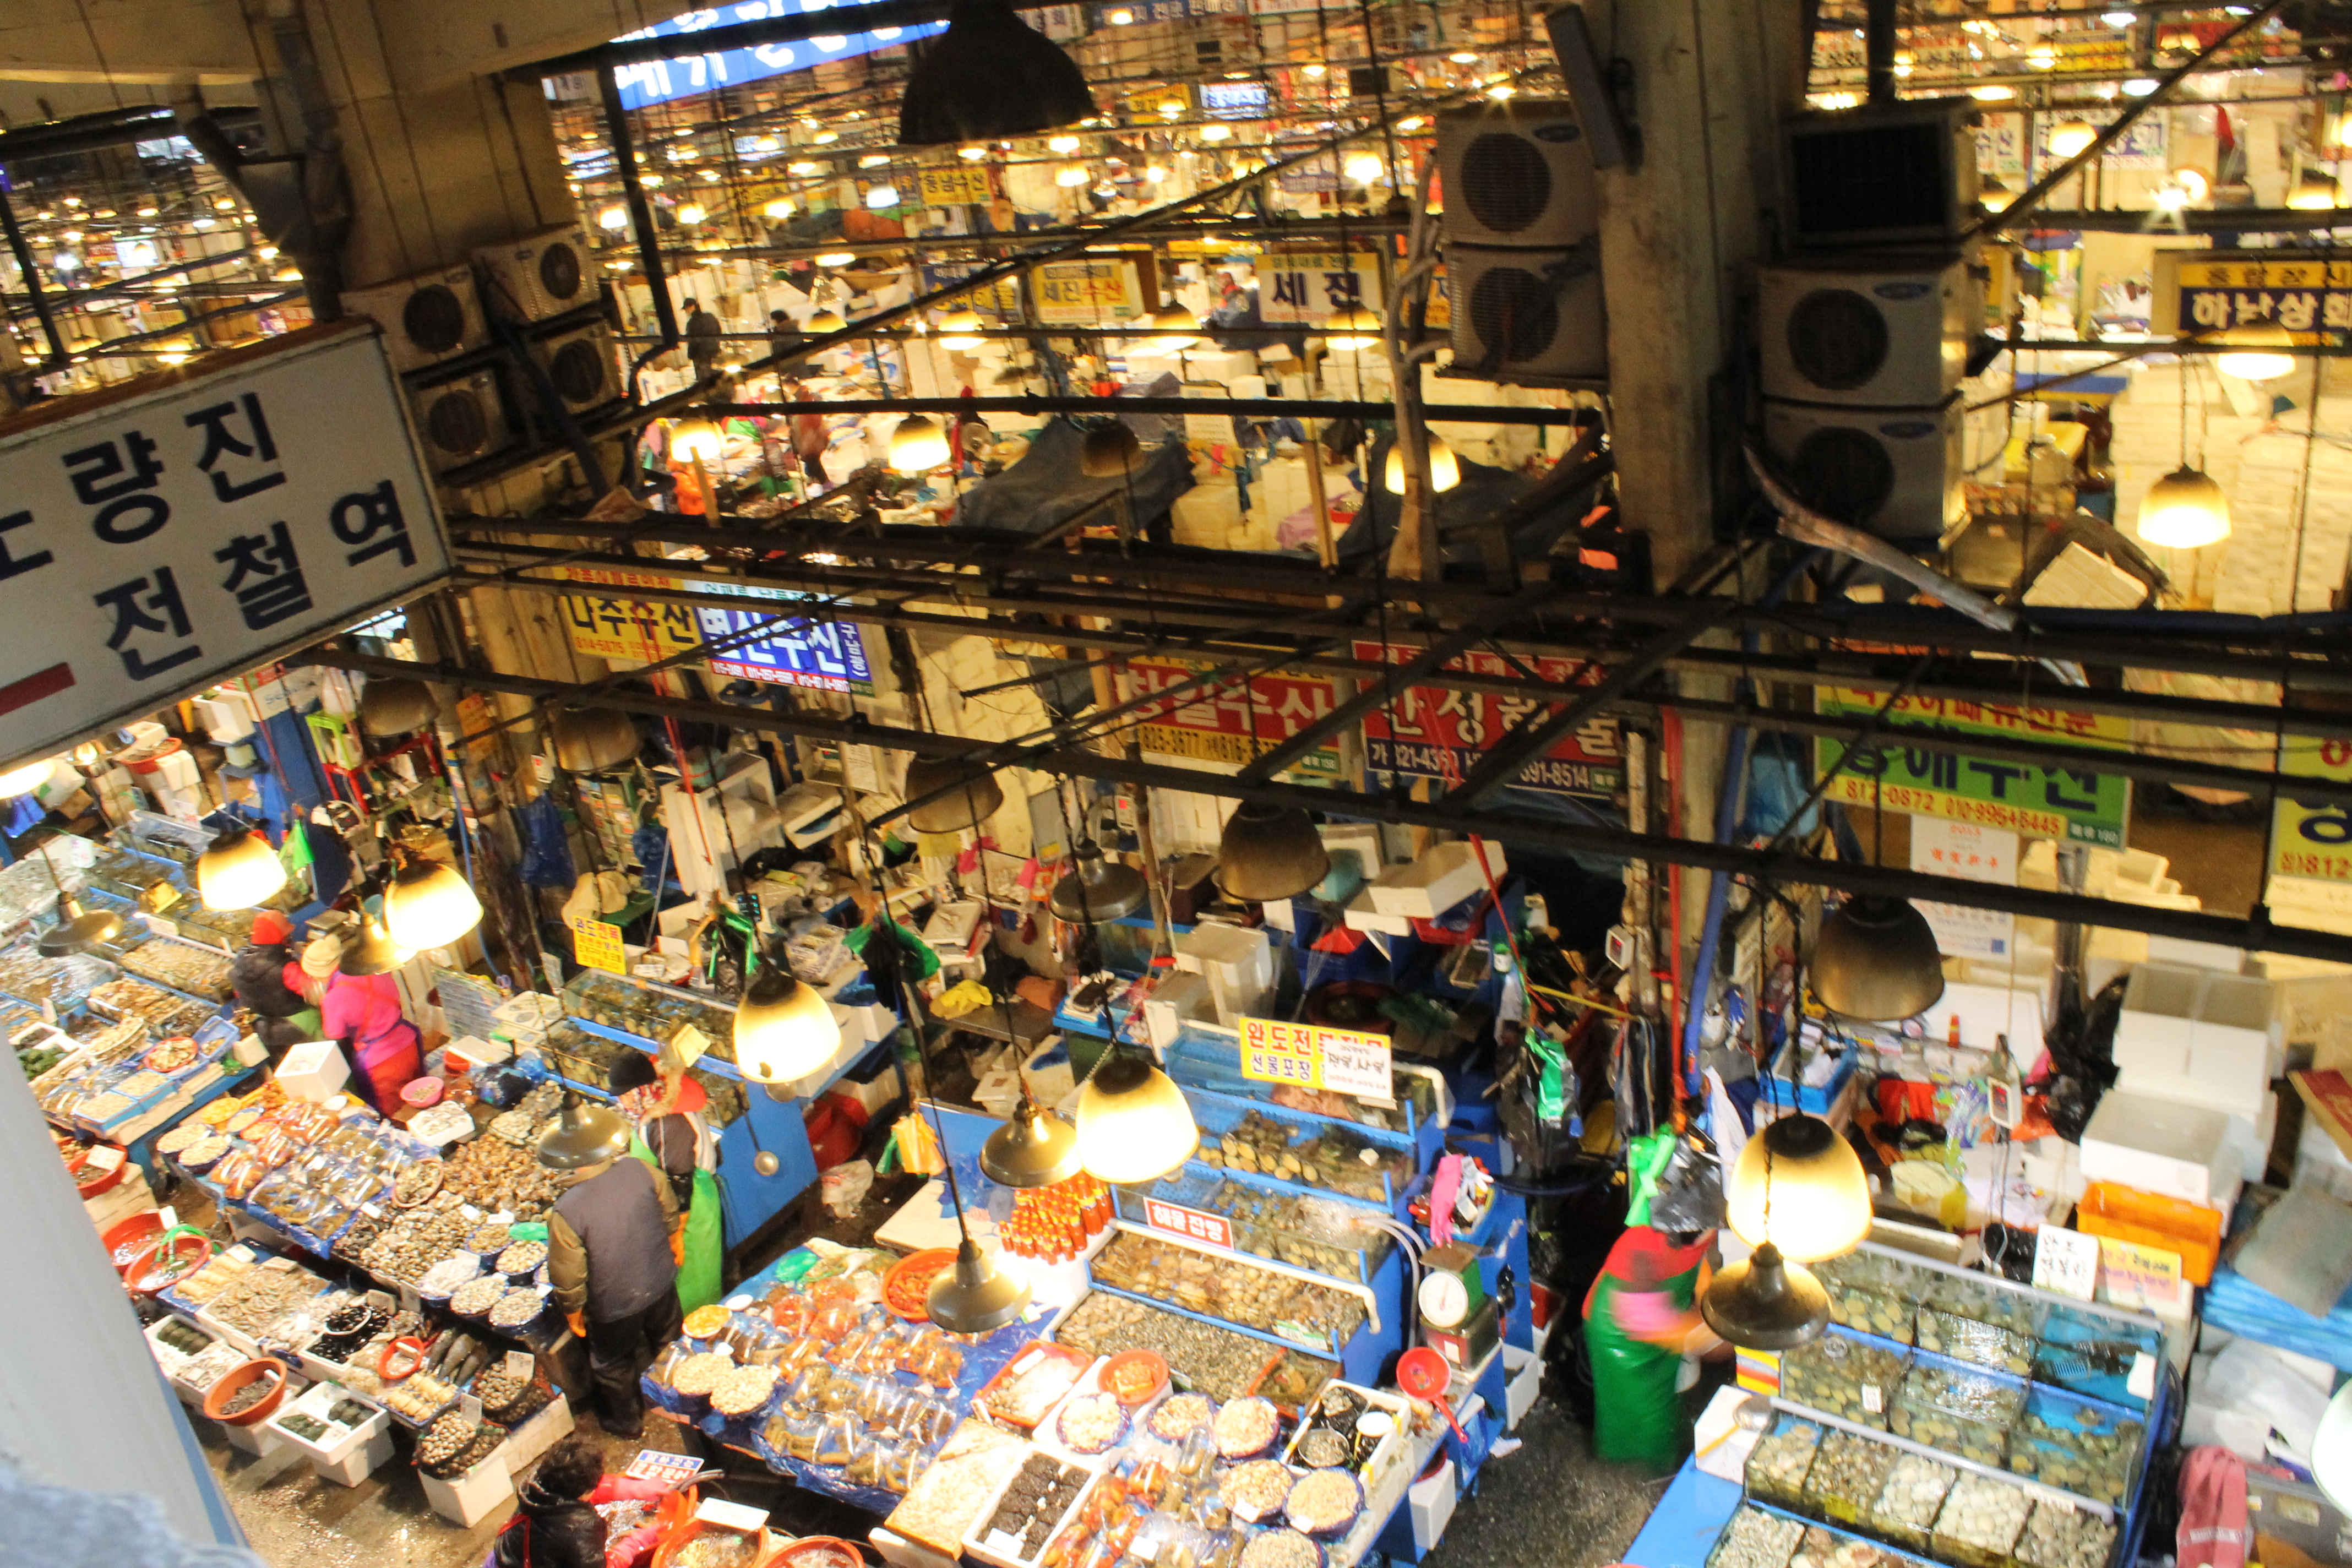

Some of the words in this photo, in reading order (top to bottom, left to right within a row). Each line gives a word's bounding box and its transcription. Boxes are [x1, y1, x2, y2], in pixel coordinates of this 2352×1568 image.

[94, 479, 417, 683] 전철역
[566, 595, 695, 645] 나주수산
[1253, 1053, 1311, 1081] 선물포장
[1152, 1204, 1186, 1232] 해물
